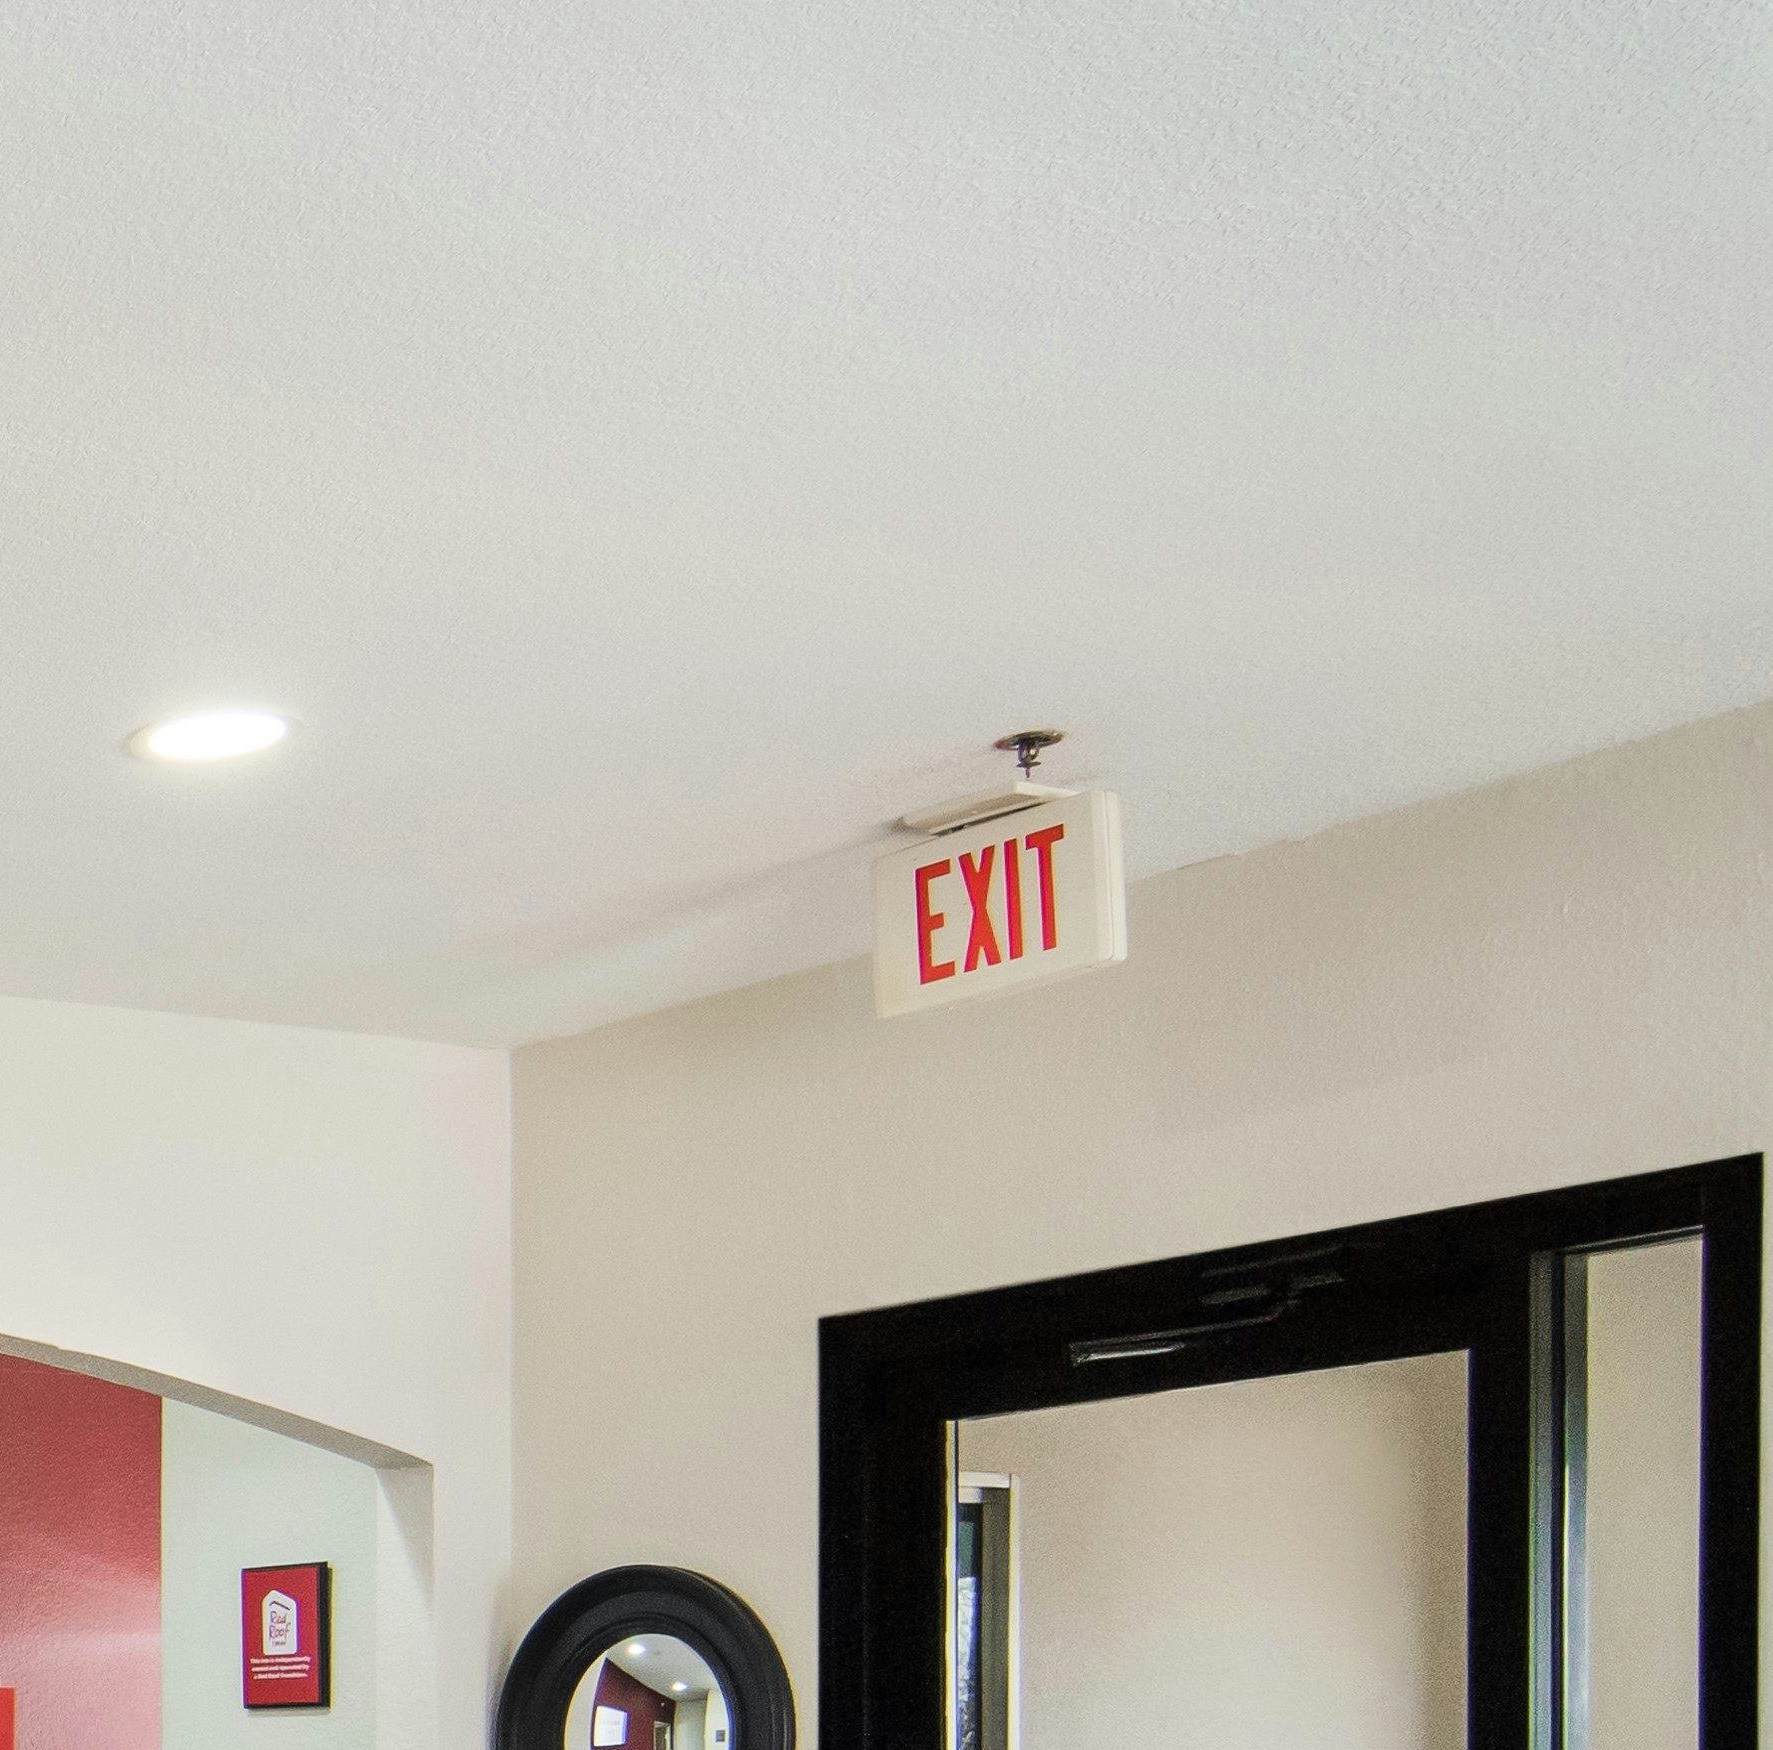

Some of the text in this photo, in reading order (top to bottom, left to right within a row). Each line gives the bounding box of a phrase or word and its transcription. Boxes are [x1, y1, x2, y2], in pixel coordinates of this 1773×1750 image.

[915, 823, 1065, 985] EXIT
[270, 1610, 287, 1624] Red
[269, 1622, 291, 1640] Roof
